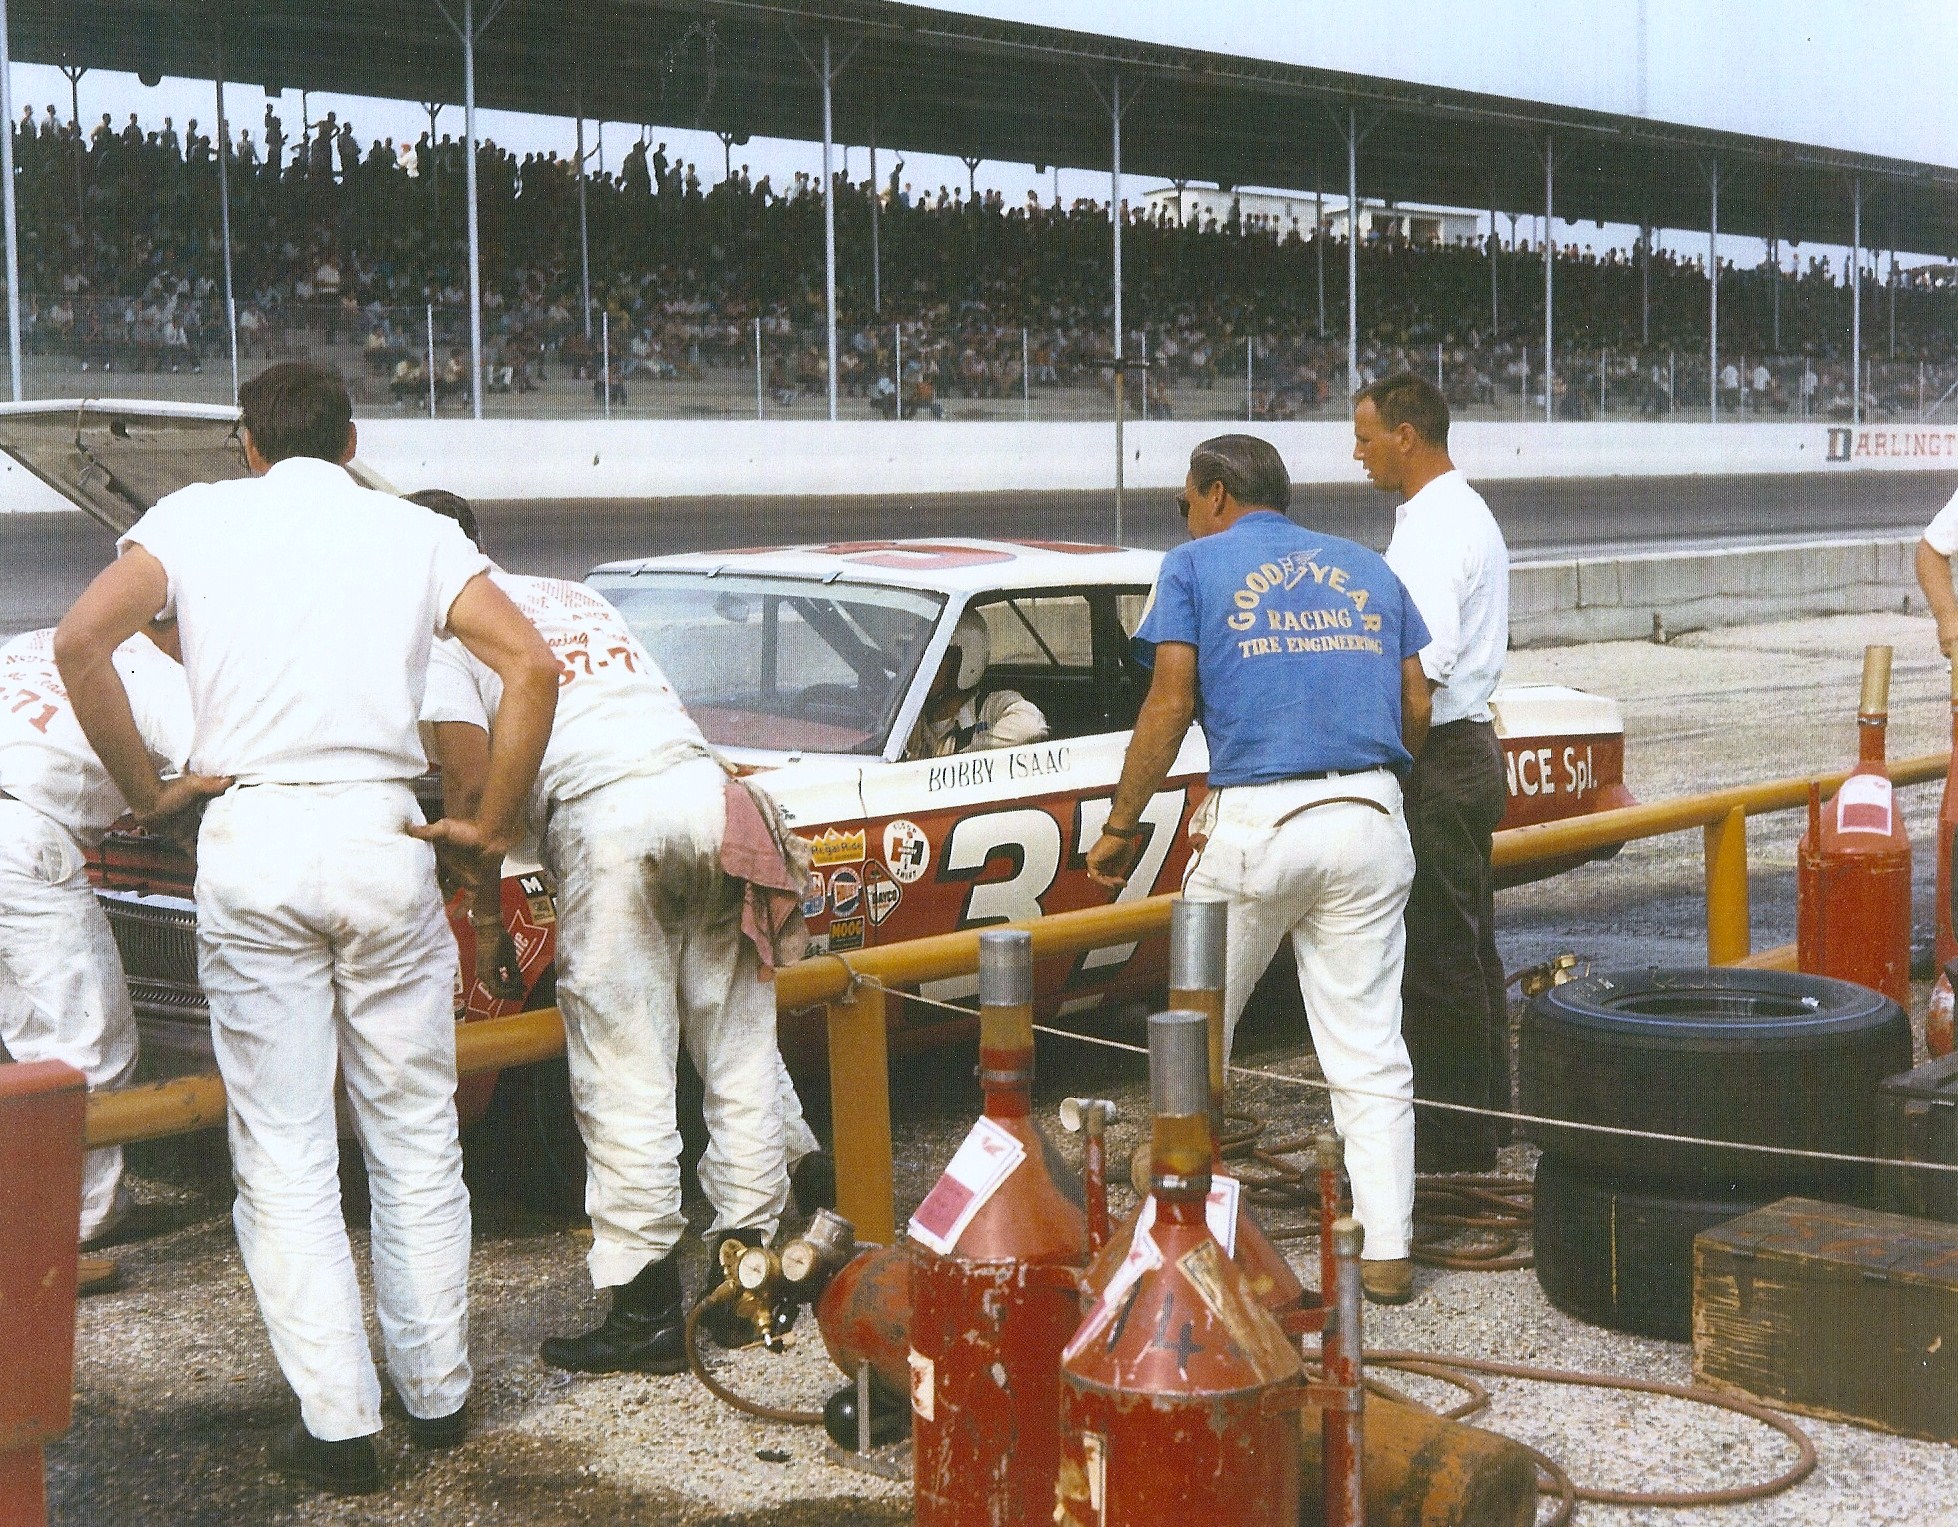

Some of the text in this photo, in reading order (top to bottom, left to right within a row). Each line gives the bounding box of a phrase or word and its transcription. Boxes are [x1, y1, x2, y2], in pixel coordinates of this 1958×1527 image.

[1825, 428, 1956, 462] DARLINGT
[1228, 562, 1383, 632] GOODYEAR
[1267, 608, 1352, 631] RACING
[549, 632, 588, 648] acing
[1238, 634, 1384, 658] TIRE ENGINEERING
[928, 746, 1071, 792] BOBBY ISAAC
[1563, 745, 1598, 800] Spl.
